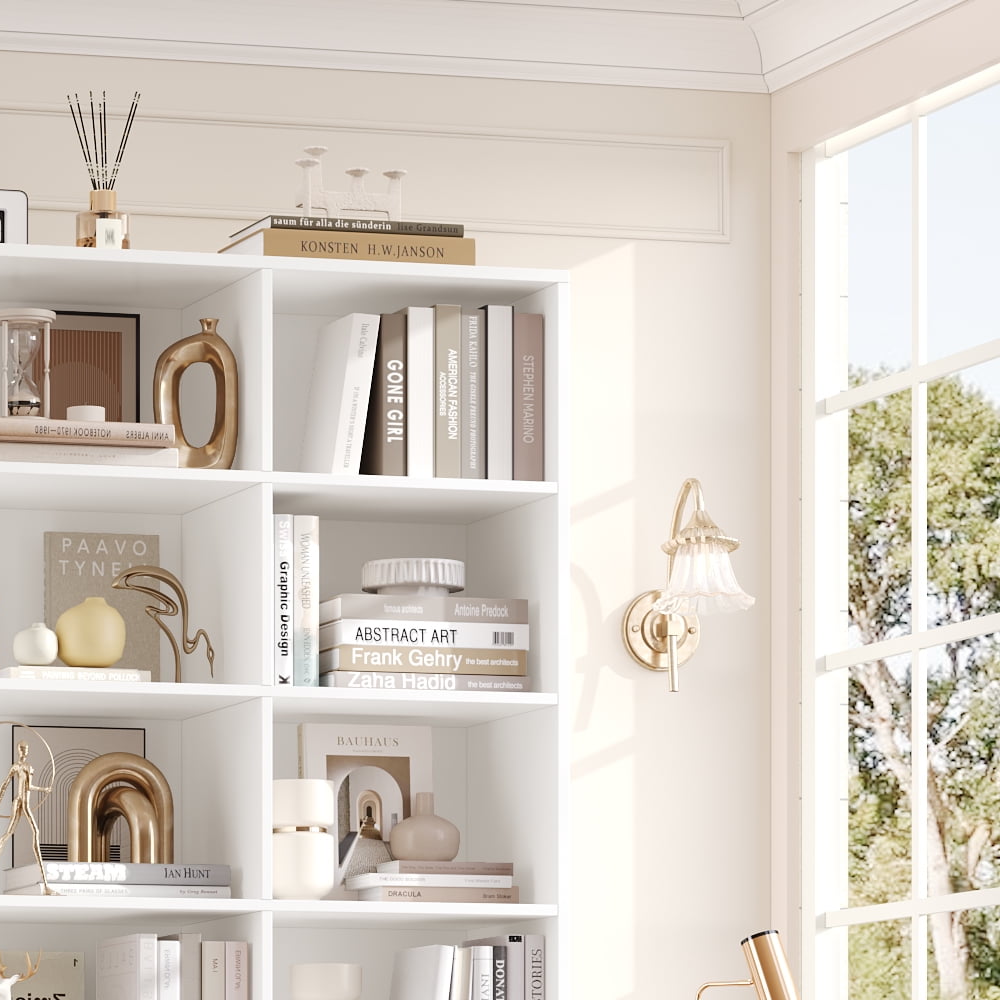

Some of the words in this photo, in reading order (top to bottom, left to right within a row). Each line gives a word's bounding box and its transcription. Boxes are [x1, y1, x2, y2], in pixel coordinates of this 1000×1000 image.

[273, 218, 297, 226] saum
[300, 217, 314, 226] für
[316, 218, 332, 227] alla
[335, 219, 349, 228] die
[352, 220, 392, 231] sünderin
[301, 240, 358, 254] KONSTEN
[368, 243, 445, 258] H.W.JANSON
[387, 359, 403, 403] GONE
[448, 349, 458, 397] AMERICAN
[522, 355, 534, 400] STEPHEN
[439, 371, 447, 416] ACCESSORIES
[387, 410, 403, 442] GIRL
[448, 399, 458, 440] FASHION
[522, 403, 534, 443] MARINO
[62, 538, 146, 556] PAAVO
[277, 561, 290, 610] Graphic
[454, 603, 480, 616] Antoine
[482, 604, 508, 617] Predock
[277, 614, 290, 657] Design
[355, 626, 427, 643] ABSTRACT
[431, 628, 457, 644] ART
[352, 647, 402, 666] Frank
[409, 649, 462, 672] Gehry
[348, 673, 395, 689] Zaha
[402, 674, 455, 690] Hadid
[336, 736, 400, 747] BAUHAUS
[46, 862, 126, 881] STEAM
[164, 867, 181, 878] IAN
[183, 868, 211, 879] HUNT
[388, 890, 421, 898] DRACULA
